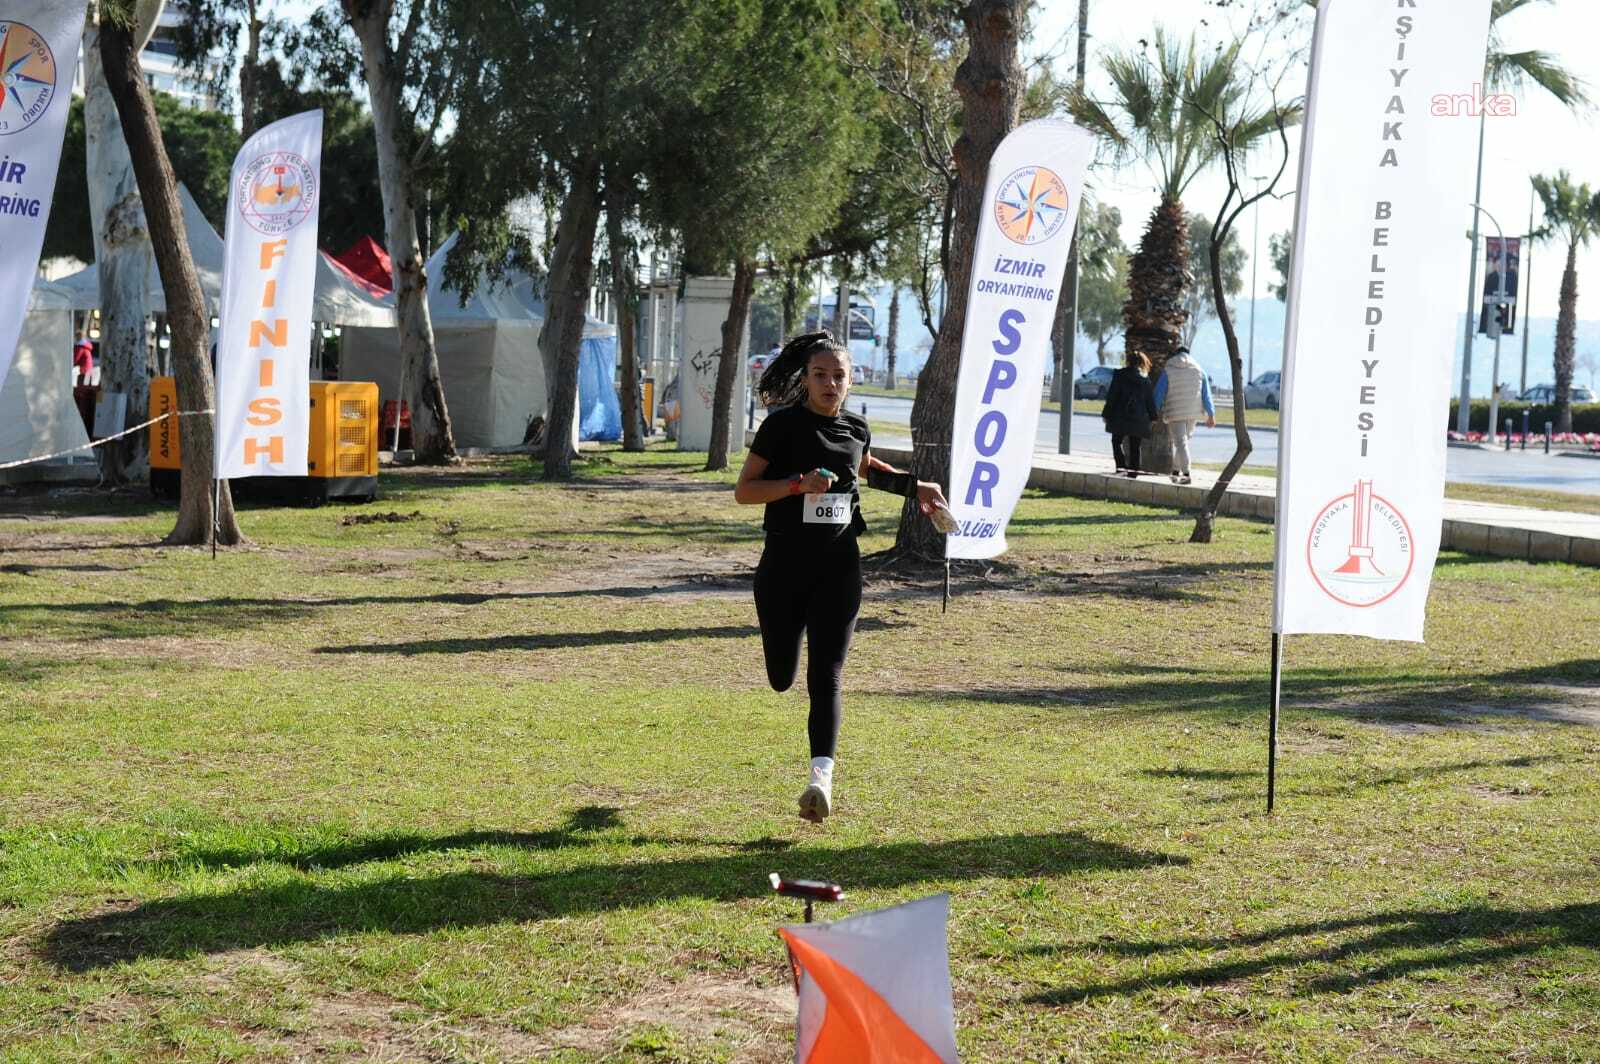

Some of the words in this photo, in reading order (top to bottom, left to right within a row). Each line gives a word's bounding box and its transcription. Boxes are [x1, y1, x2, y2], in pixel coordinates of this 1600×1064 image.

[28, 38, 49, 64] SPOR
[994, 254, 1046, 278] İZMİR
[243, 239, 289, 464] FINISH
[1357, 201, 1392, 457] BELEDİYESİ
[964, 309, 1026, 508] SPOR
[816, 506, 845, 518] 0807
